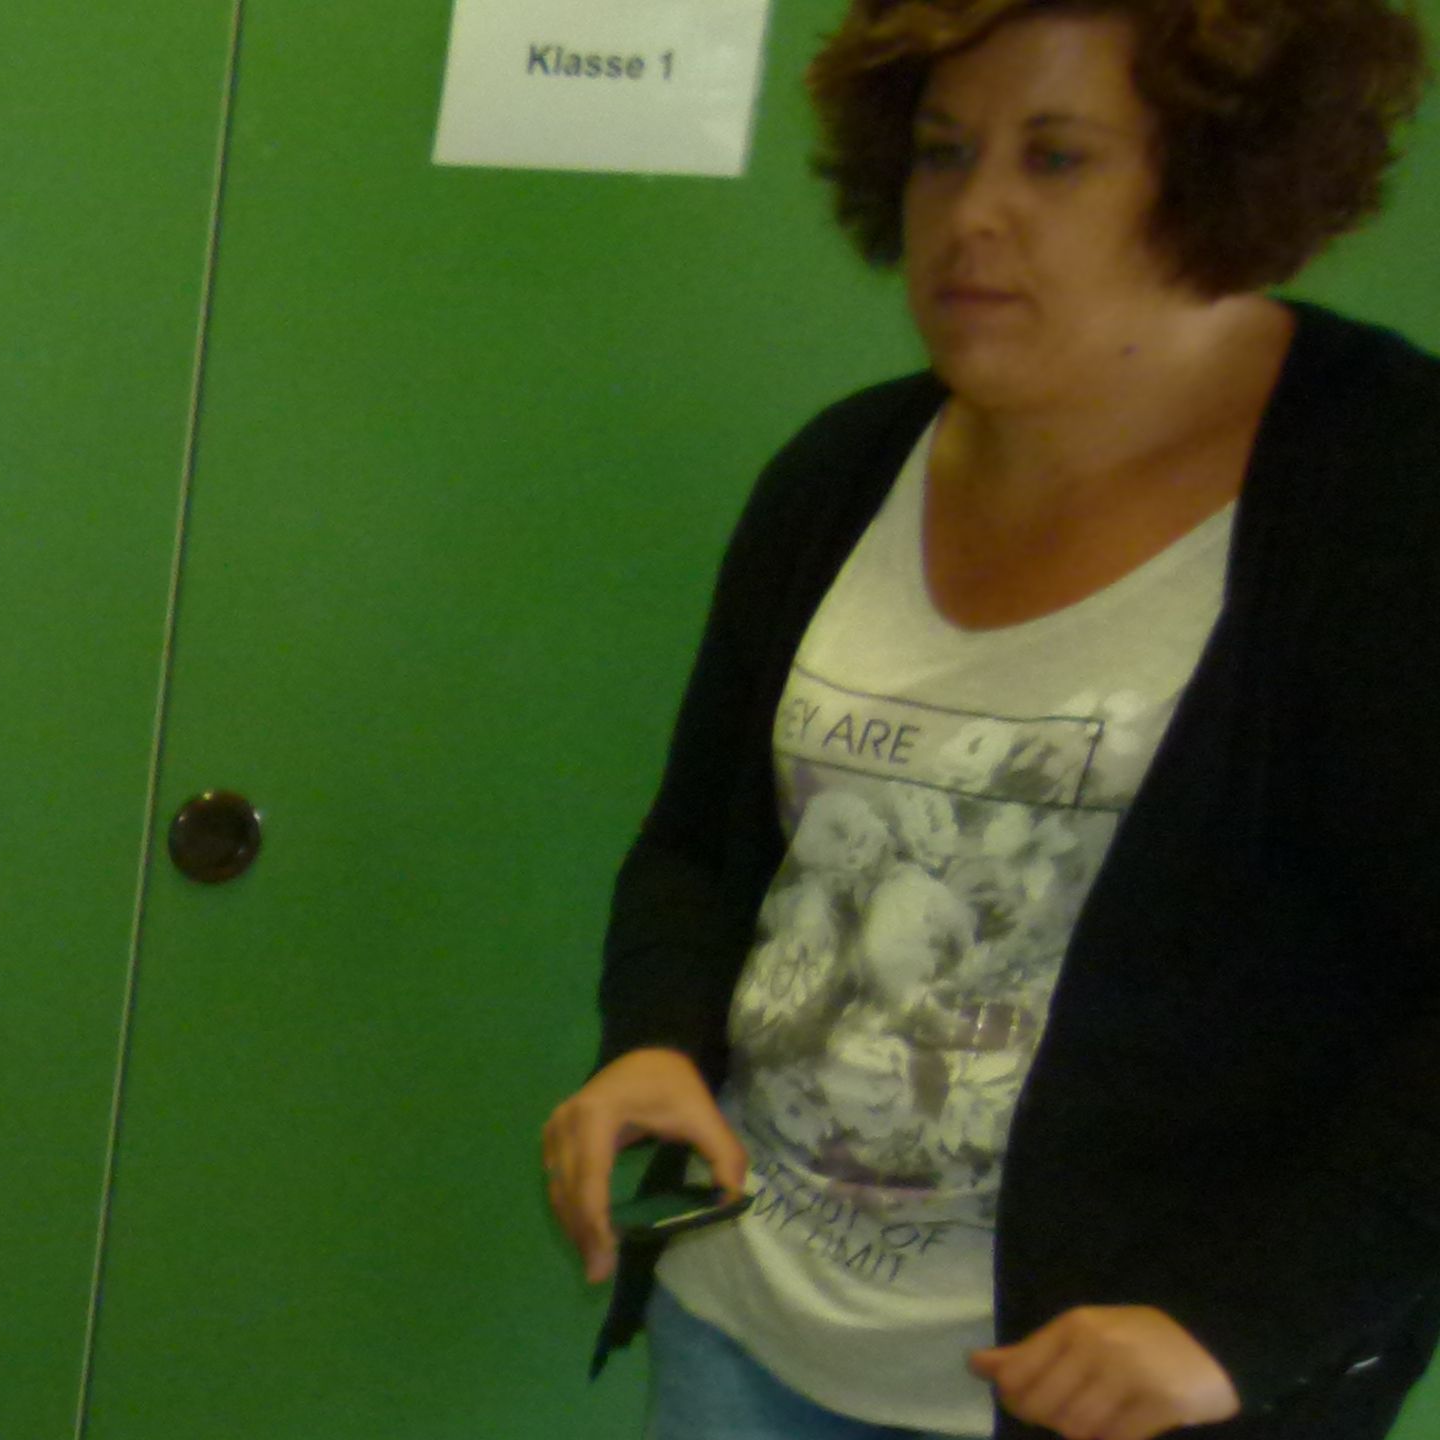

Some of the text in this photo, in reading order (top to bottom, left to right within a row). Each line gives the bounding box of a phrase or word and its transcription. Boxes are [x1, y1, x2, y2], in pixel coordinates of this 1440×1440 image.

[525, 42, 676, 82] Klasse 1
[822, 712, 920, 764] ARE
